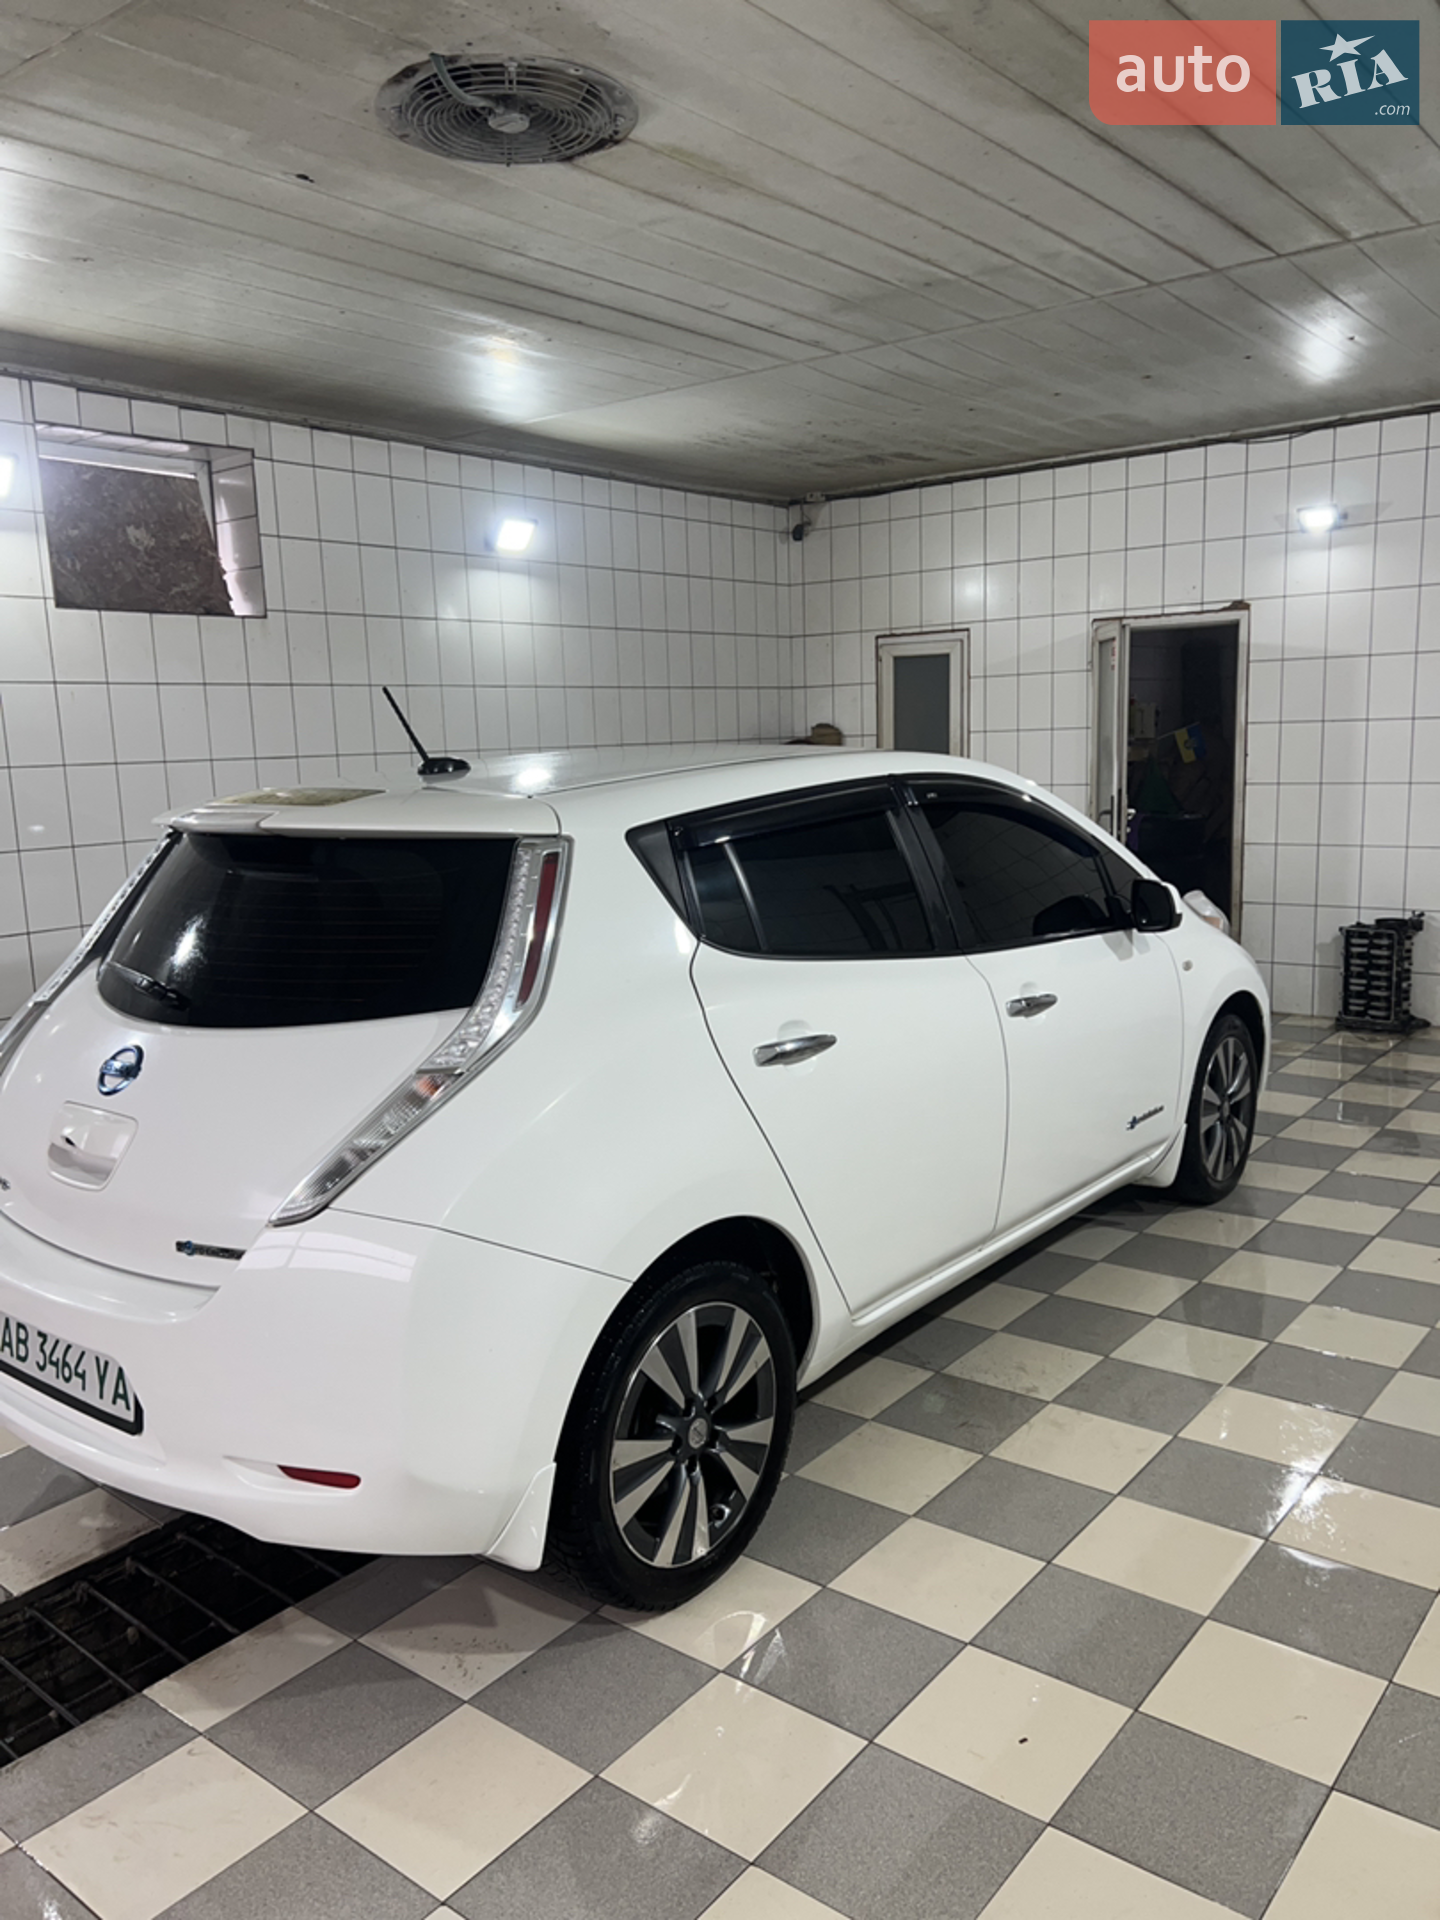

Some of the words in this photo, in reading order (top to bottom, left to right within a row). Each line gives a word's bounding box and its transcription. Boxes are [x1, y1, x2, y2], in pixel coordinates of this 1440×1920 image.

[0, 1316, 29, 1363] AB
[35, 1330, 86, 1392] 3464
[95, 1355, 131, 1411] YA
